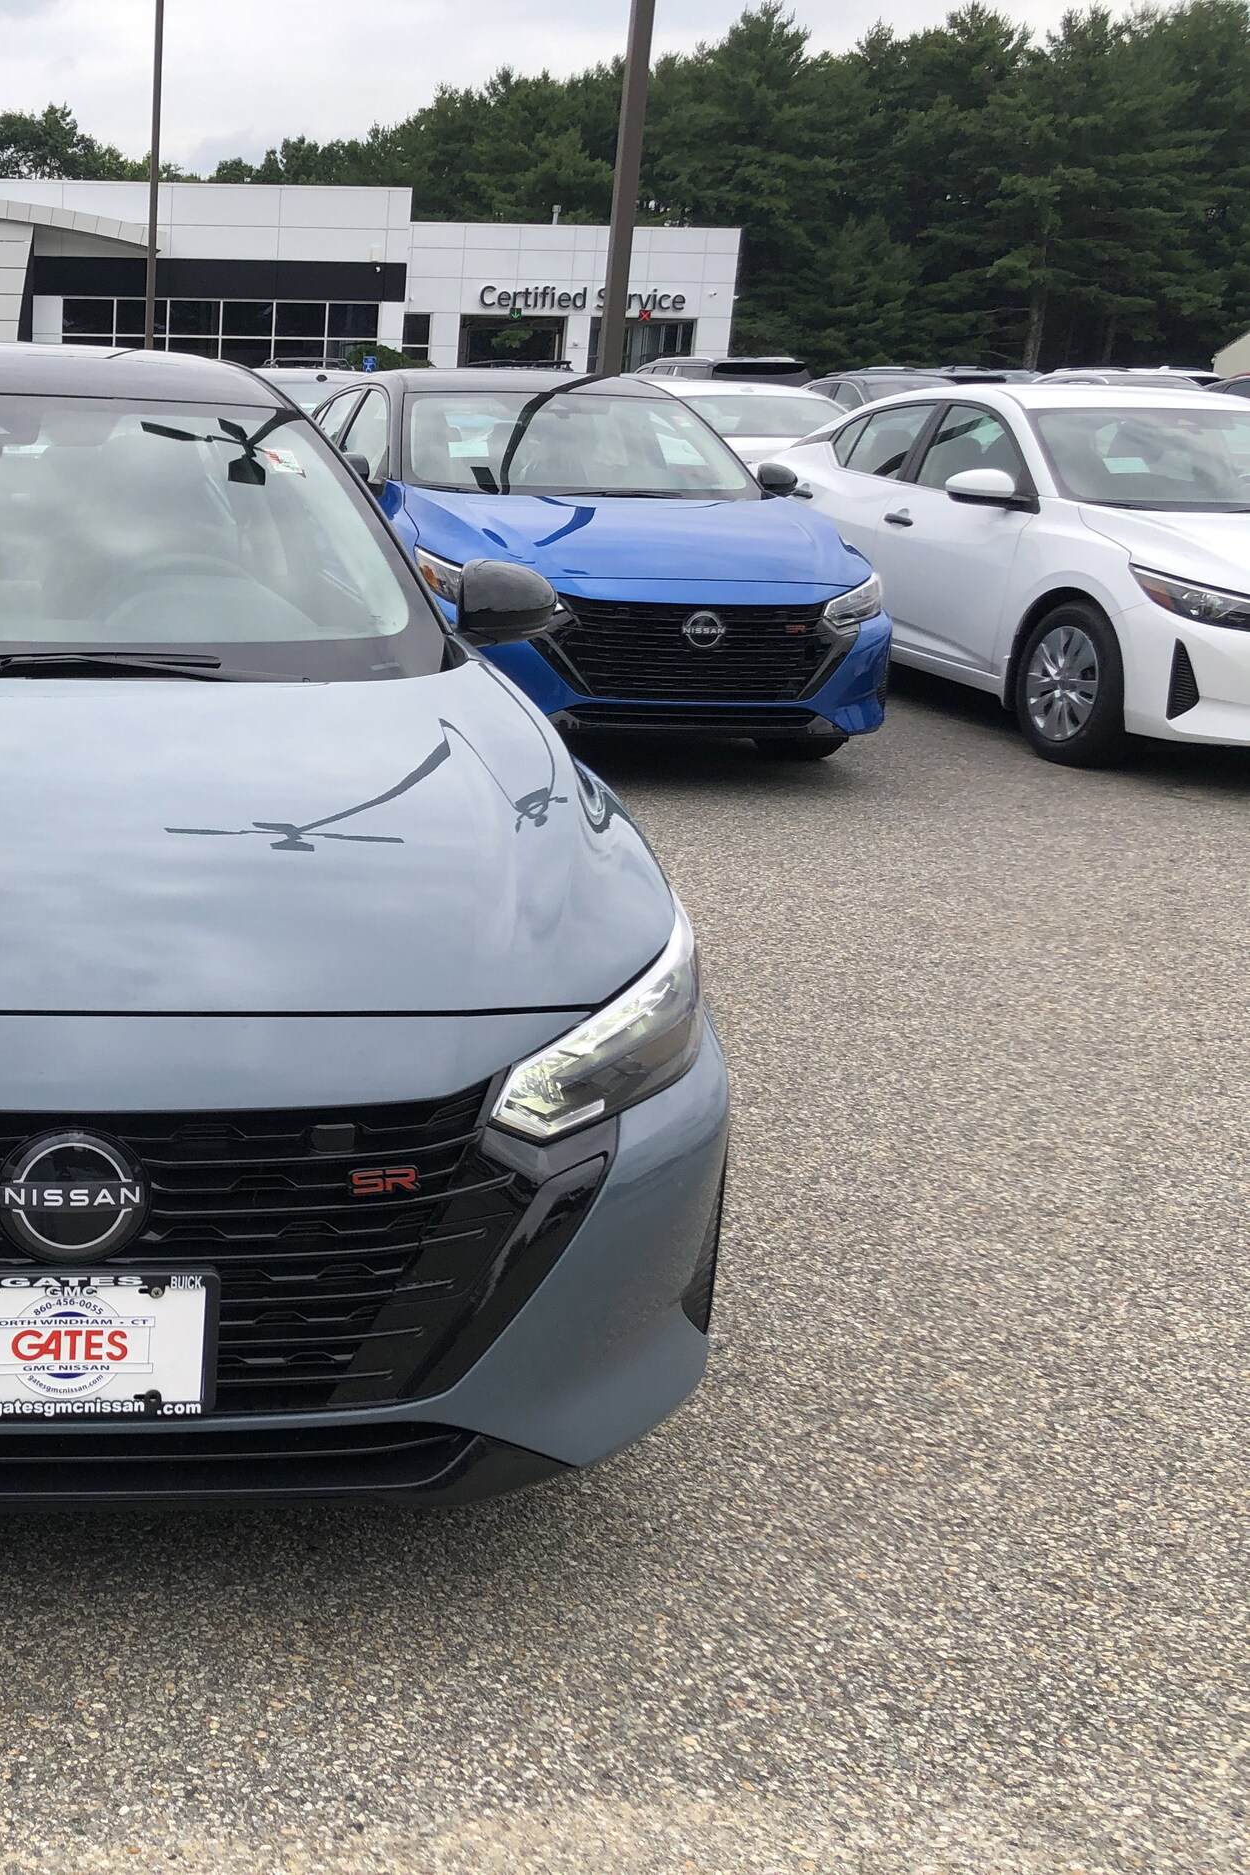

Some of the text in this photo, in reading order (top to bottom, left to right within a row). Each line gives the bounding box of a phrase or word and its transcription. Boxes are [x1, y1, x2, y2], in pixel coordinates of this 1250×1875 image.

[479, 285, 686, 310] Certified Srvice
[785, 625, 807, 633] SR
[351, 1168, 418, 1194] SR
[4, 1186, 140, 1207] NISSAN
[0, 1276, 143, 1288] GATES
[170, 1275, 203, 1290] BUICK
[45, 1286, 98, 1298] GMC
[33, 1298, 104, 1316] 860-456-0055
[11, 1330, 128, 1361] GATES
[22, 1364, 56, 1372] GMC
[27, 1374, 104, 1394] gatesgmcnissan.com
[156, 1403, 202, 1416] .com
